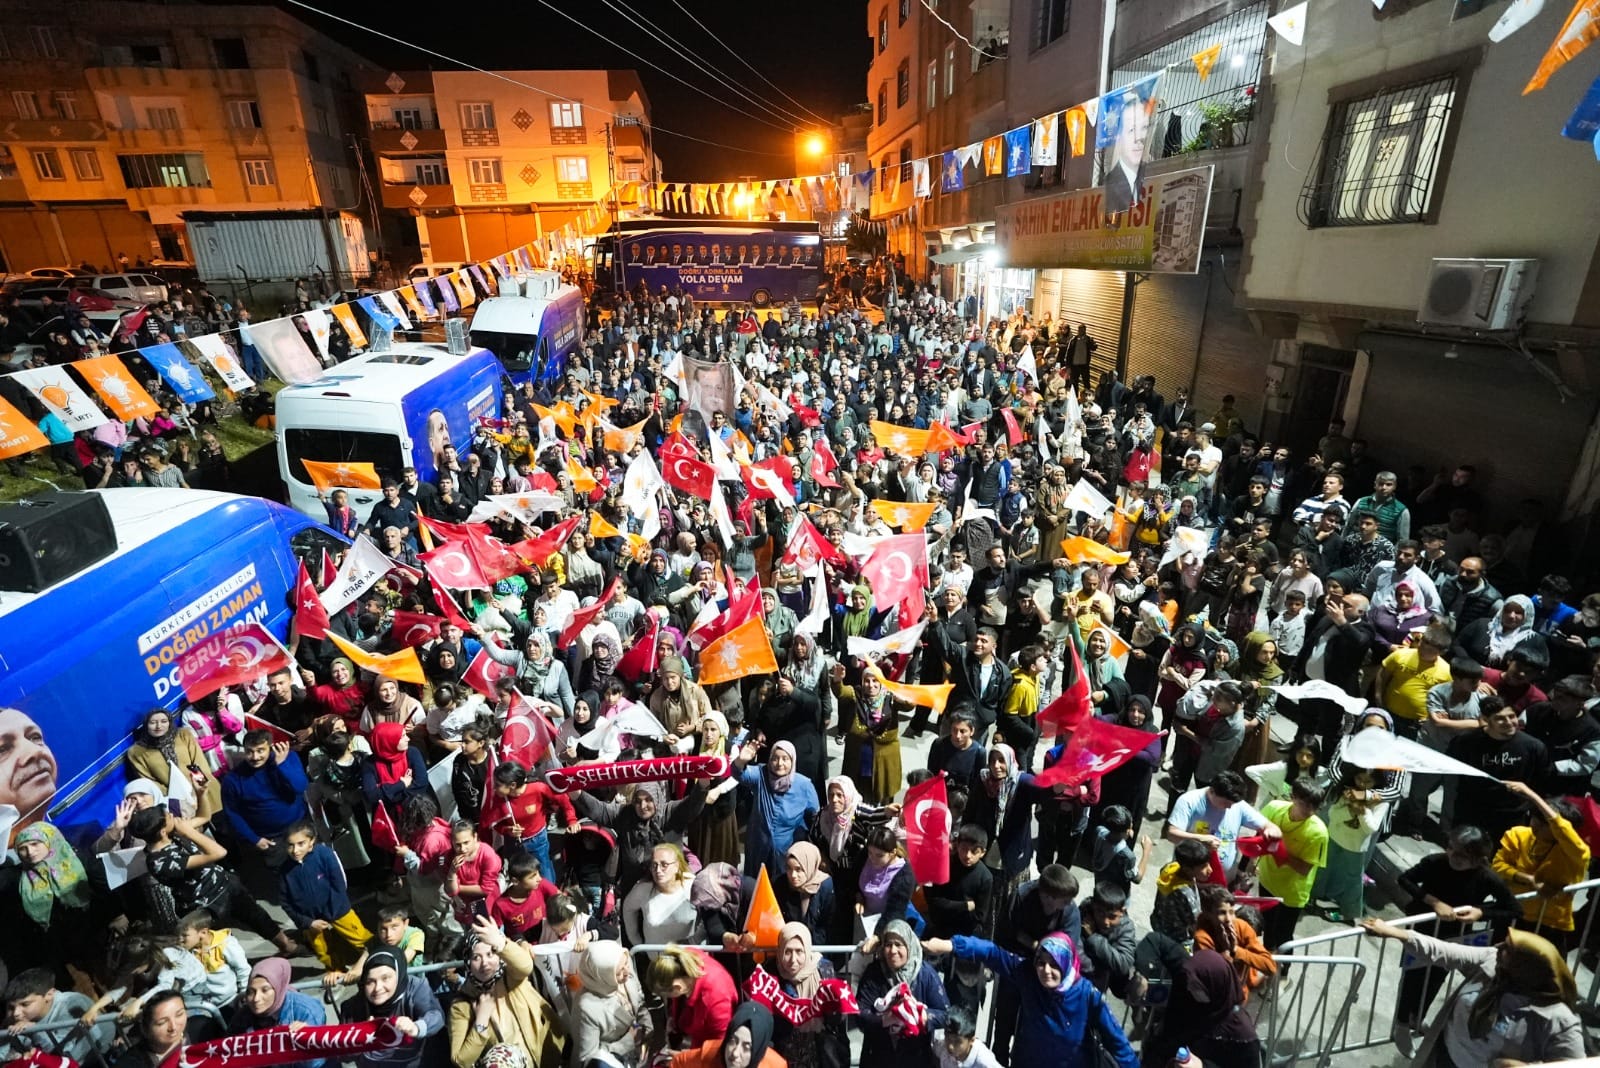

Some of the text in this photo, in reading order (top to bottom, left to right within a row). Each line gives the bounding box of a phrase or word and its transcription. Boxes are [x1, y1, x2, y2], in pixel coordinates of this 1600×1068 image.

[1051, 193, 1102, 233] EMLAK
[679, 275, 743, 284] YOLA DEVAM
[146, 571, 253, 644] TÜRKİYE YÜZYILI İÇİN
[144, 581, 263, 676] DOĞRU ZAMAN
[153, 637, 222, 700] DOĞRU
[576, 758, 696, 787] ŞEHİTKAMİL
[220, 1027, 364, 1065] ŞEHİTKAMİL
